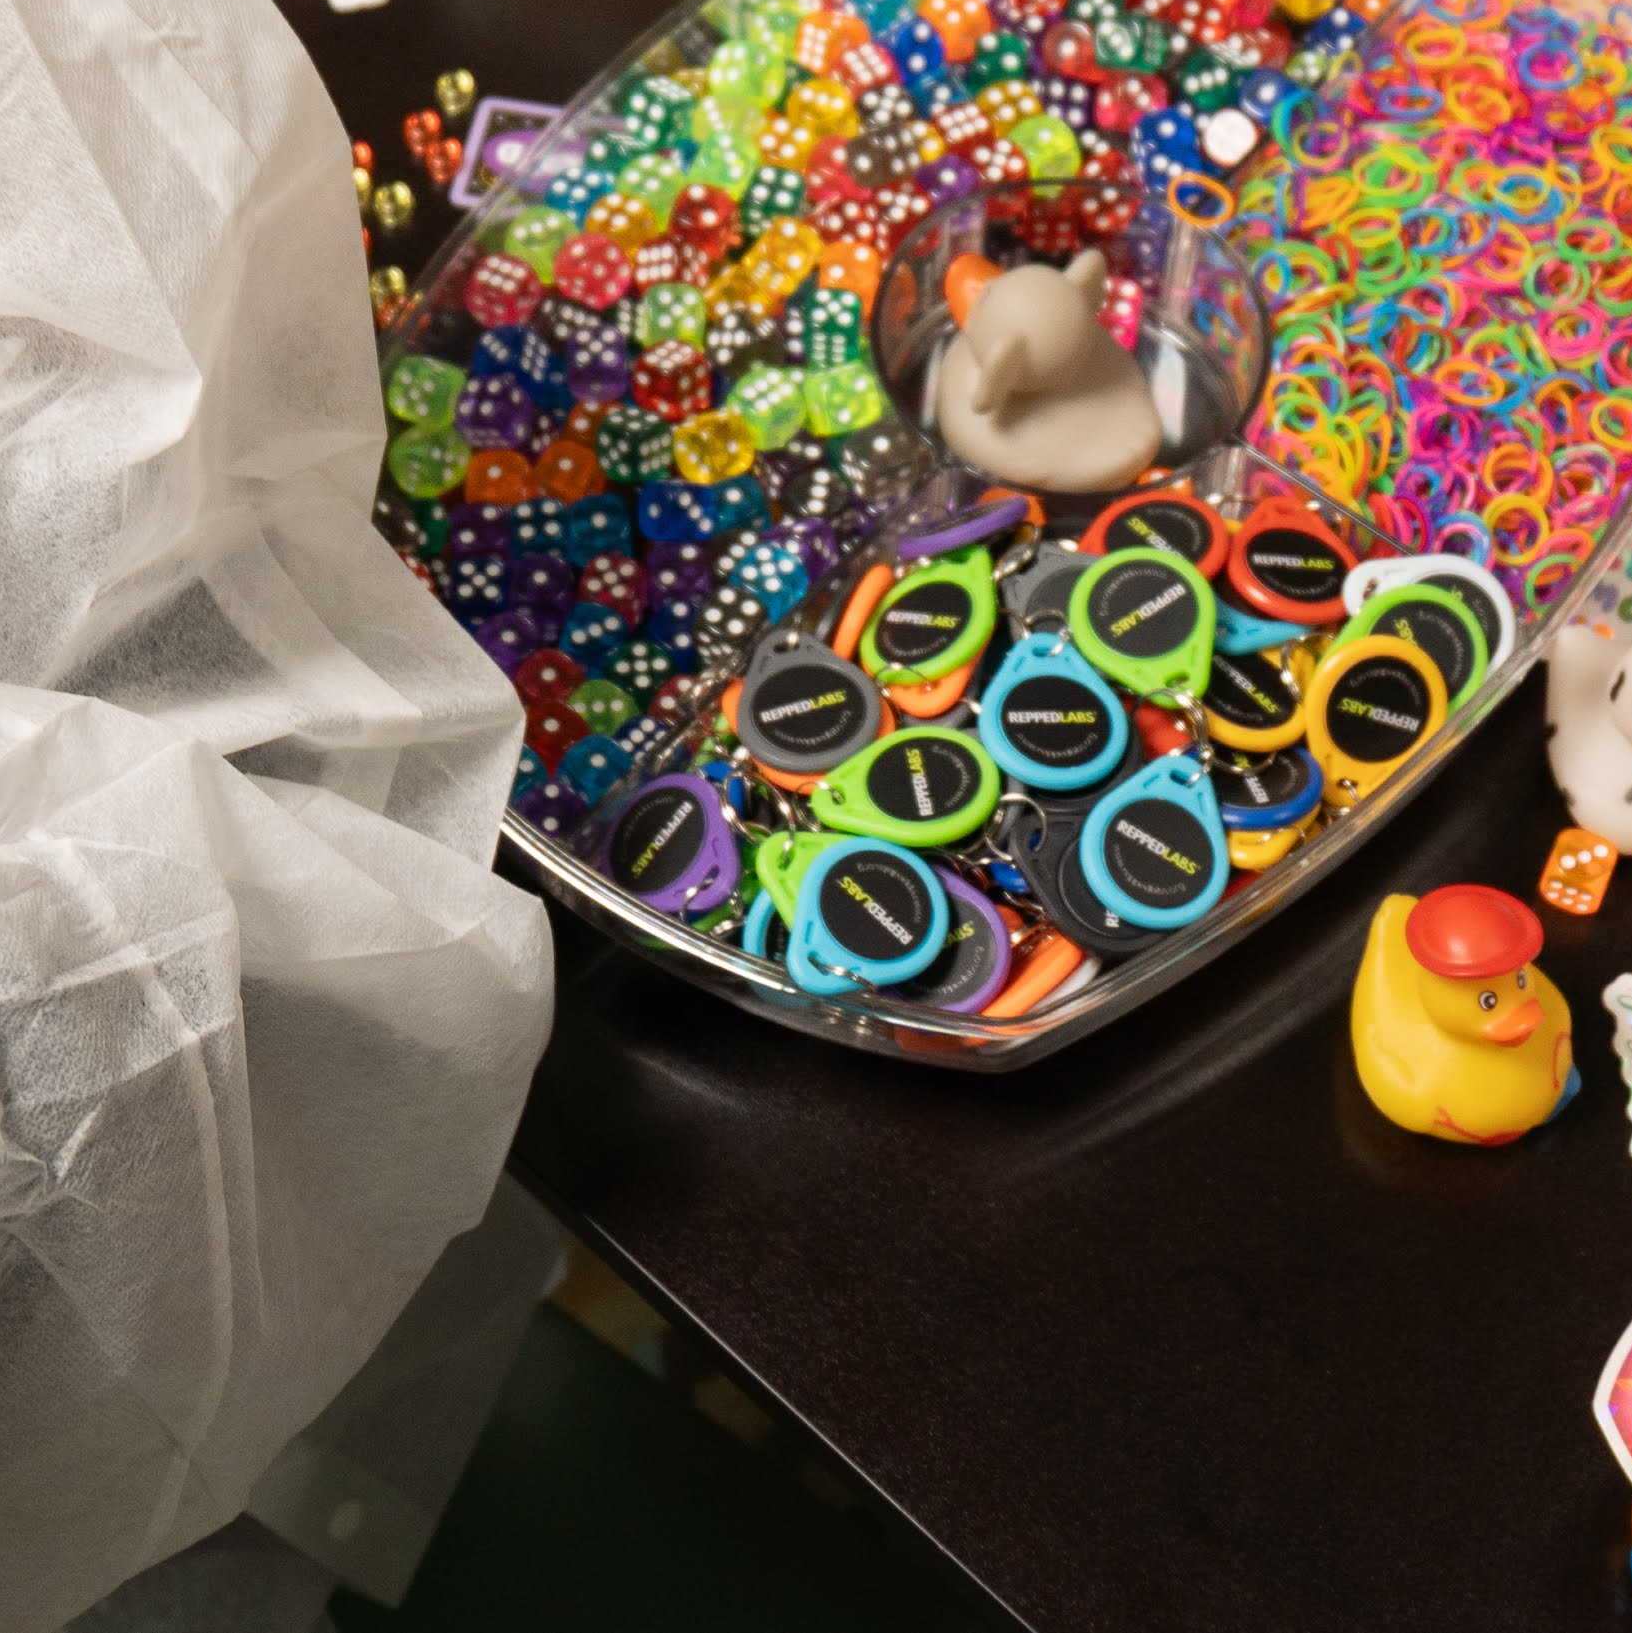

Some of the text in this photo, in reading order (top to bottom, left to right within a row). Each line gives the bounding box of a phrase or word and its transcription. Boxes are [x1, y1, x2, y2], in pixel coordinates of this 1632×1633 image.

[1251, 553, 1335, 572] REPPEDLABS
[886, 609, 961, 630] REPPEDLABS
[1111, 582, 1187, 638] REPPEDLABS
[760, 689, 848, 724] REPPEDLABS
[1007, 709, 1097, 725] REPPEDLABS
[1338, 697, 1420, 732] REPPEDLABS
[905, 748, 934, 817] REPPEDLABS
[631, 800, 694, 880] REPPEDLABS
[1116, 818, 1198, 875] REPPEDLABS
[839, 874, 914, 947] REPPEDLABS
